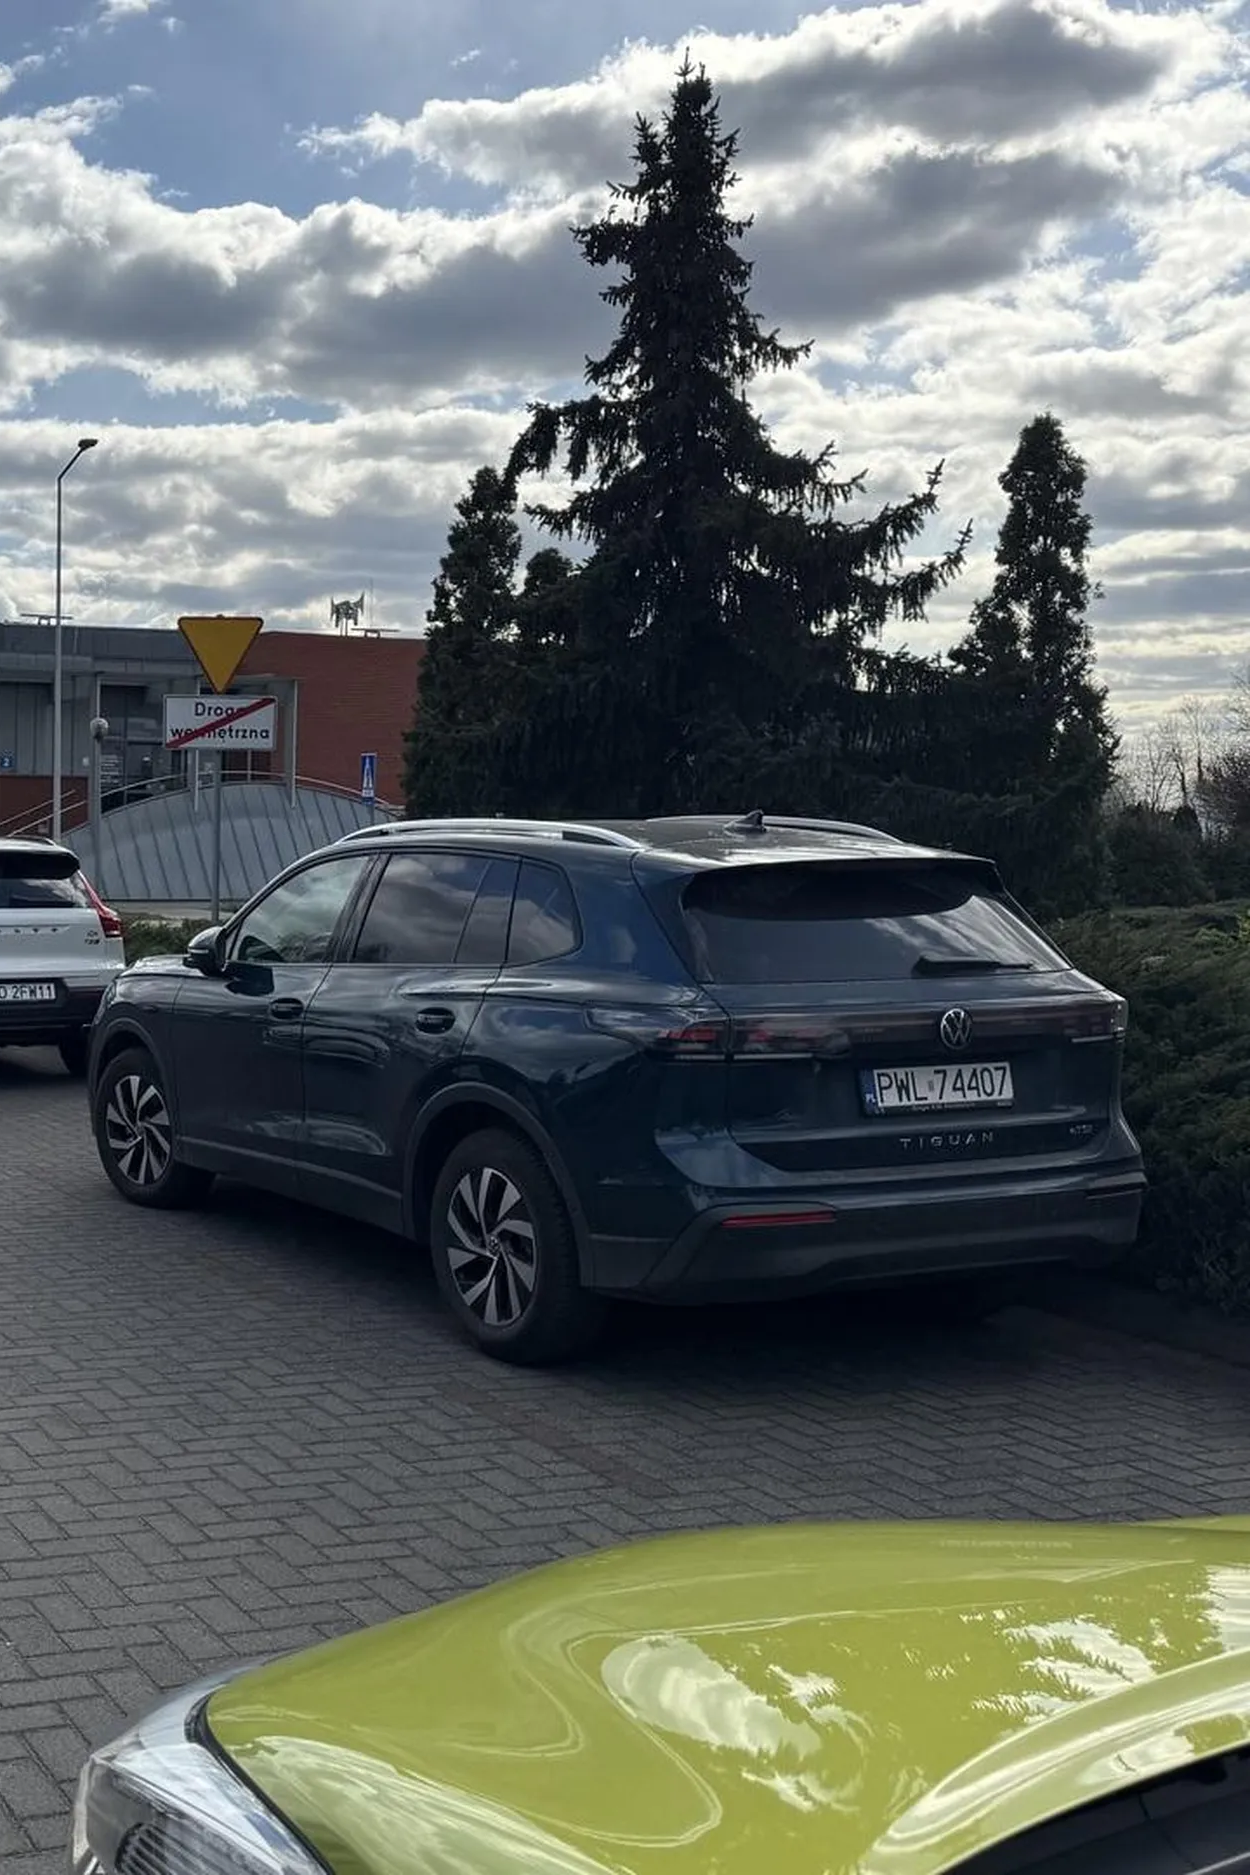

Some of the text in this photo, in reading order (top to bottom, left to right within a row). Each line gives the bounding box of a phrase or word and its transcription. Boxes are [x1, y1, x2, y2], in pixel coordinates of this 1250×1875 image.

[194, 702, 248, 721] Drog
[170, 725, 269, 743] wenętrzna
[877, 1066, 1008, 1104] PWL 74407
[899, 1131, 994, 1150] TIGUAN
